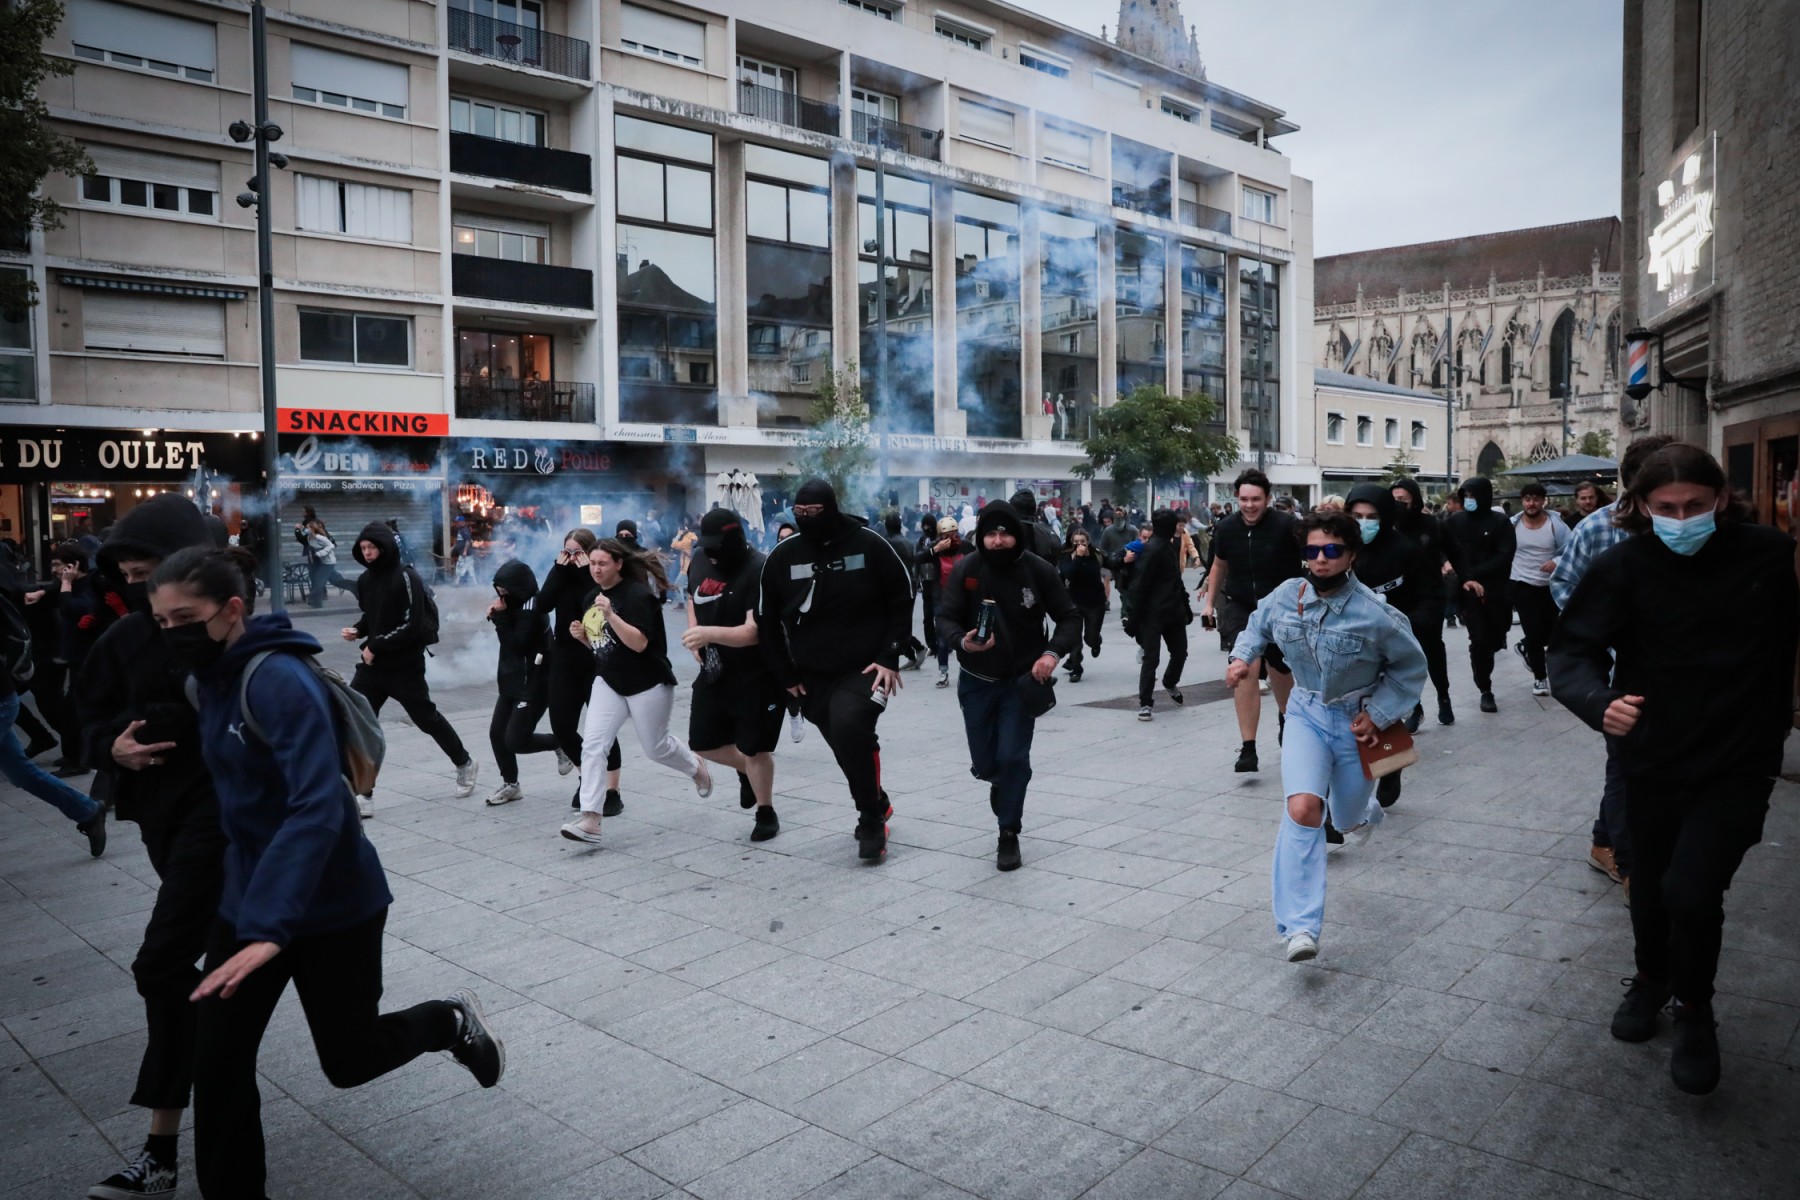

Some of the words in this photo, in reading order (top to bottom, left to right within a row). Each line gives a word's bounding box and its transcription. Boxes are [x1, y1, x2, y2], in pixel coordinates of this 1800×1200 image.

[290, 411, 429, 434] SNACKING
[613, 427, 662, 439] chaussures
[17, 439, 63, 468] DU
[98, 440, 205, 469] OULET
[471, 447, 528, 470] RED
[561, 449, 610, 471] Poule
[304, 480, 332, 490] Kebab
[341, 481, 384, 490] Sandwichs
[393, 481, 416, 490] Pizza
[424, 481, 441, 490] Grill
